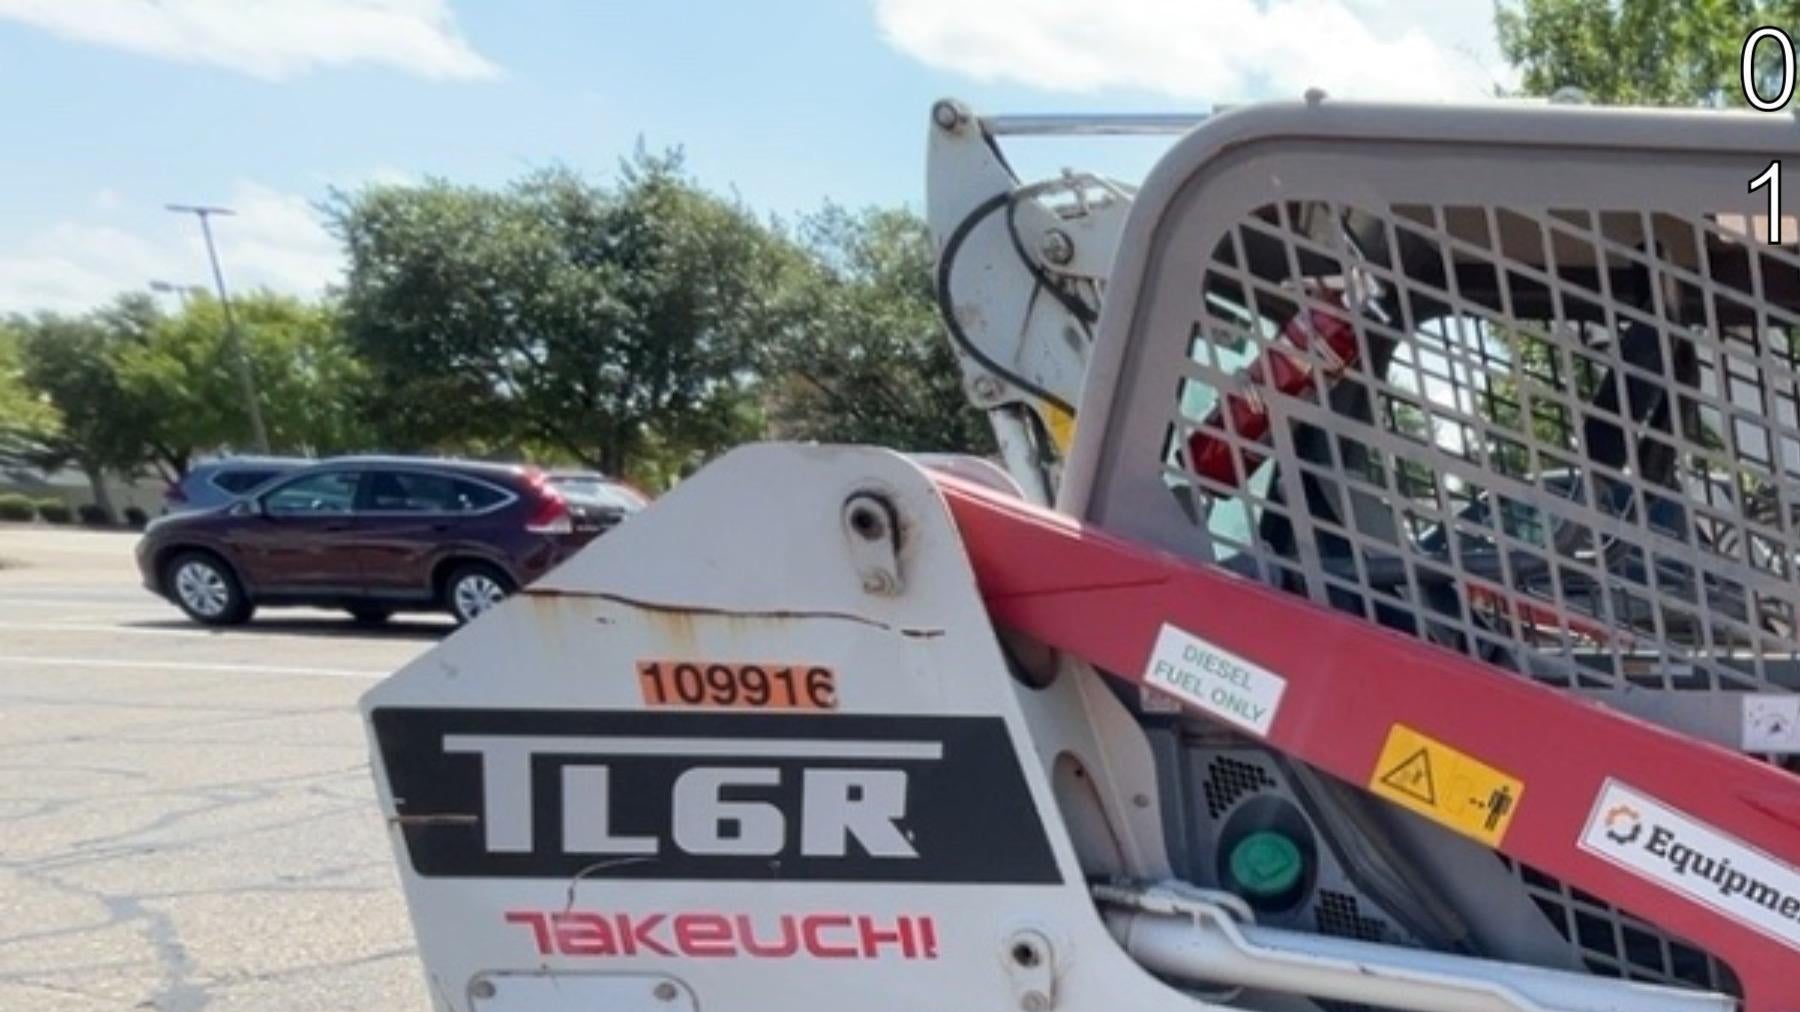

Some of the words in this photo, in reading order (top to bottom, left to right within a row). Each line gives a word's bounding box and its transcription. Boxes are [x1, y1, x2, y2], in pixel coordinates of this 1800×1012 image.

[640, 662, 836, 709] 109916
[1154, 659, 1203, 695] FUEL
[1211, 686, 1267, 722] ONLY
[1183, 644, 1253, 691] DIESEL
[442, 734, 943, 858] TL6R
